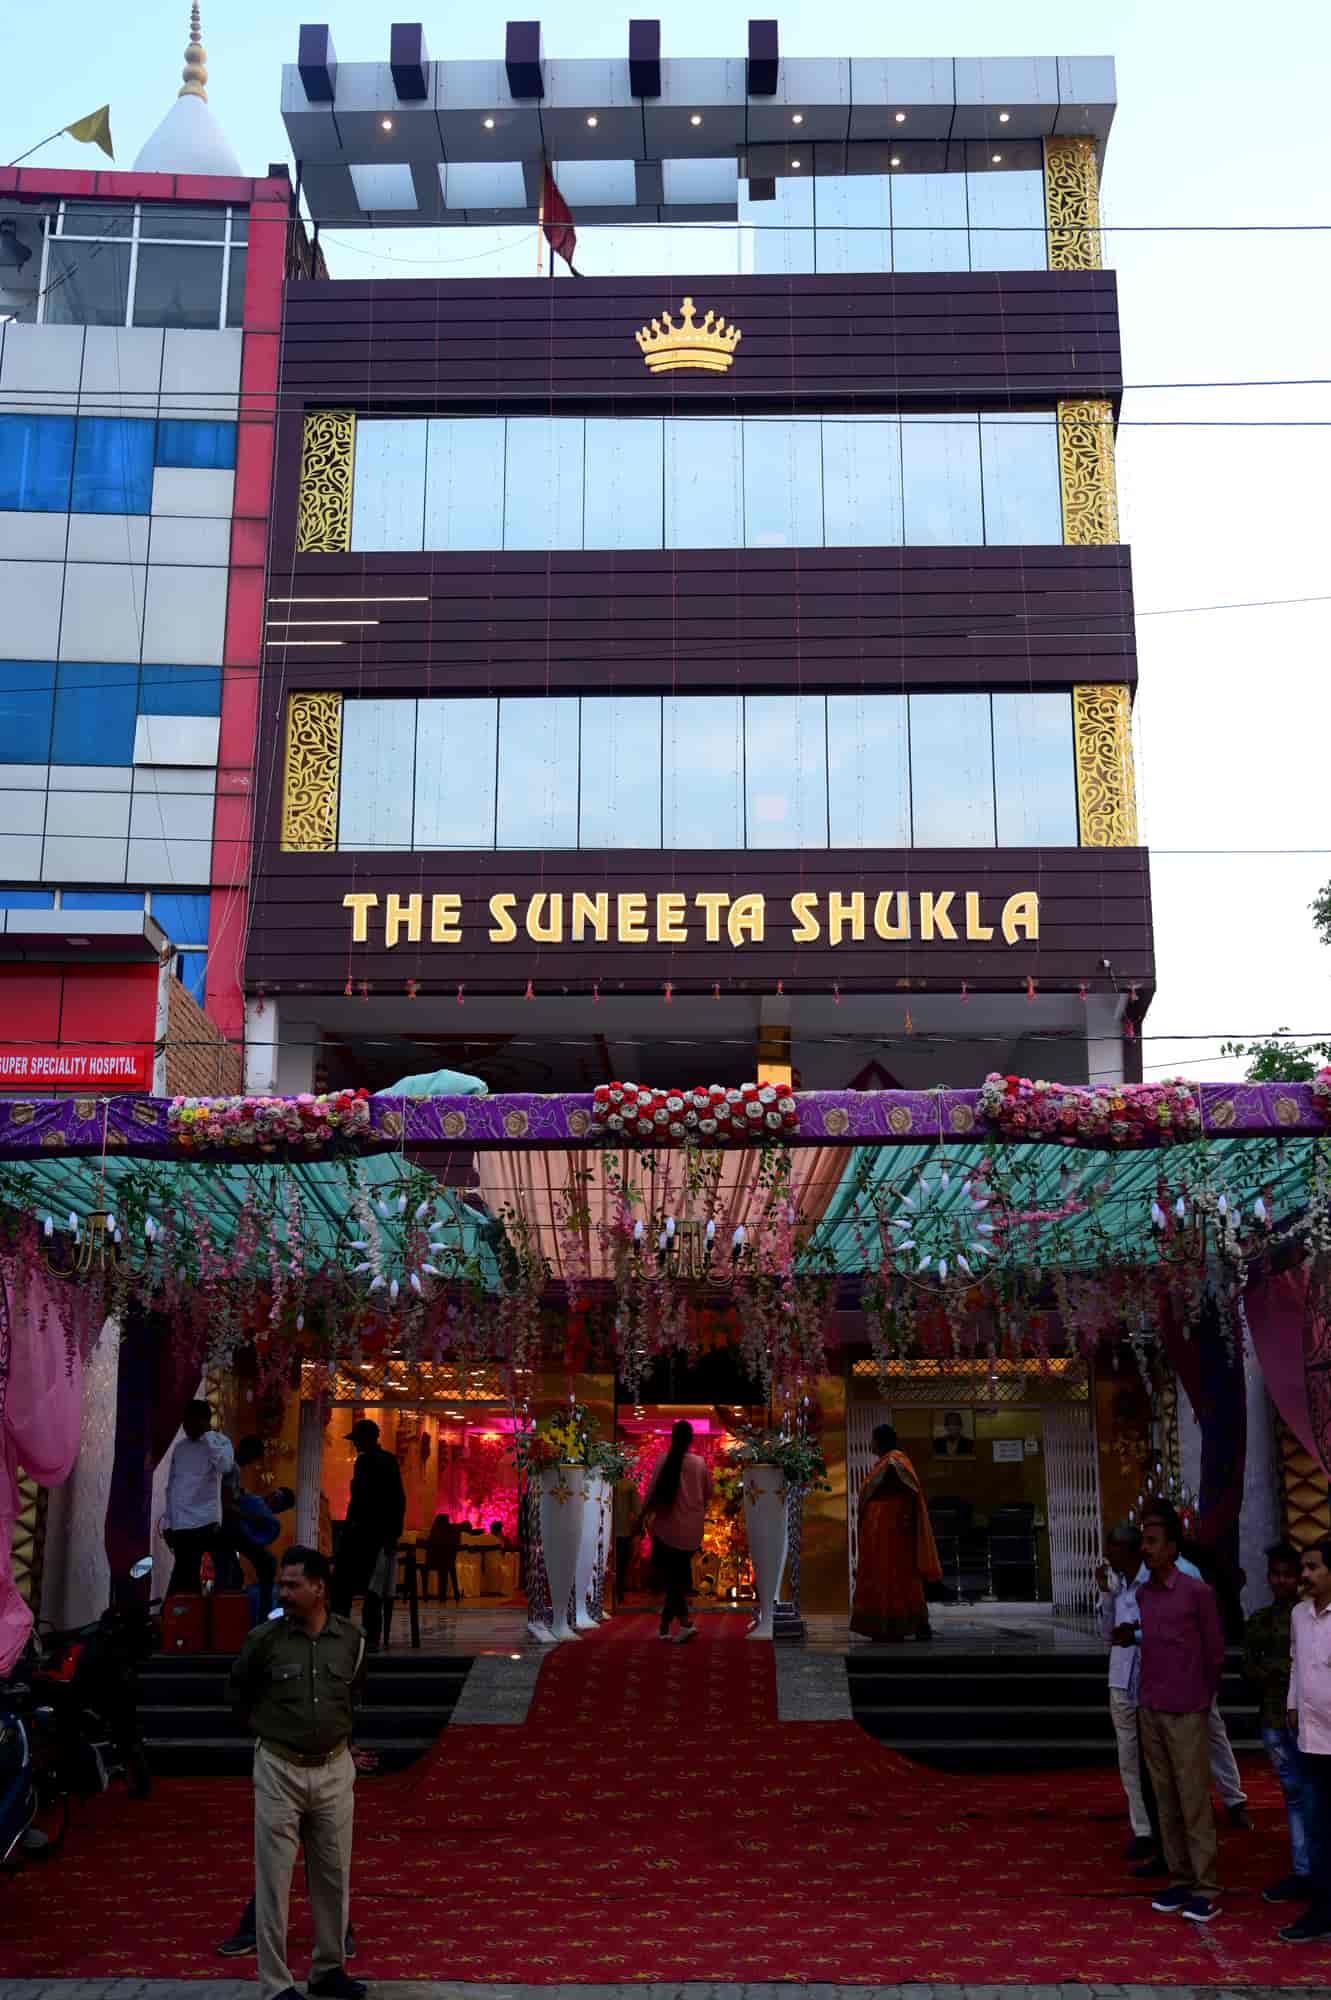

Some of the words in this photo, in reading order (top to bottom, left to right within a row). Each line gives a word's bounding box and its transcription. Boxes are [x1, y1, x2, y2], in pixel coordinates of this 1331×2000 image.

[342, 892, 463, 948] THE
[488, 892, 766, 948] SUNEETA
[790, 890, 1040, 947] SHUKLA
[30, 1056, 88, 1075] SPECIALITY
[89, 1056, 137, 1075] HOSPITAL
